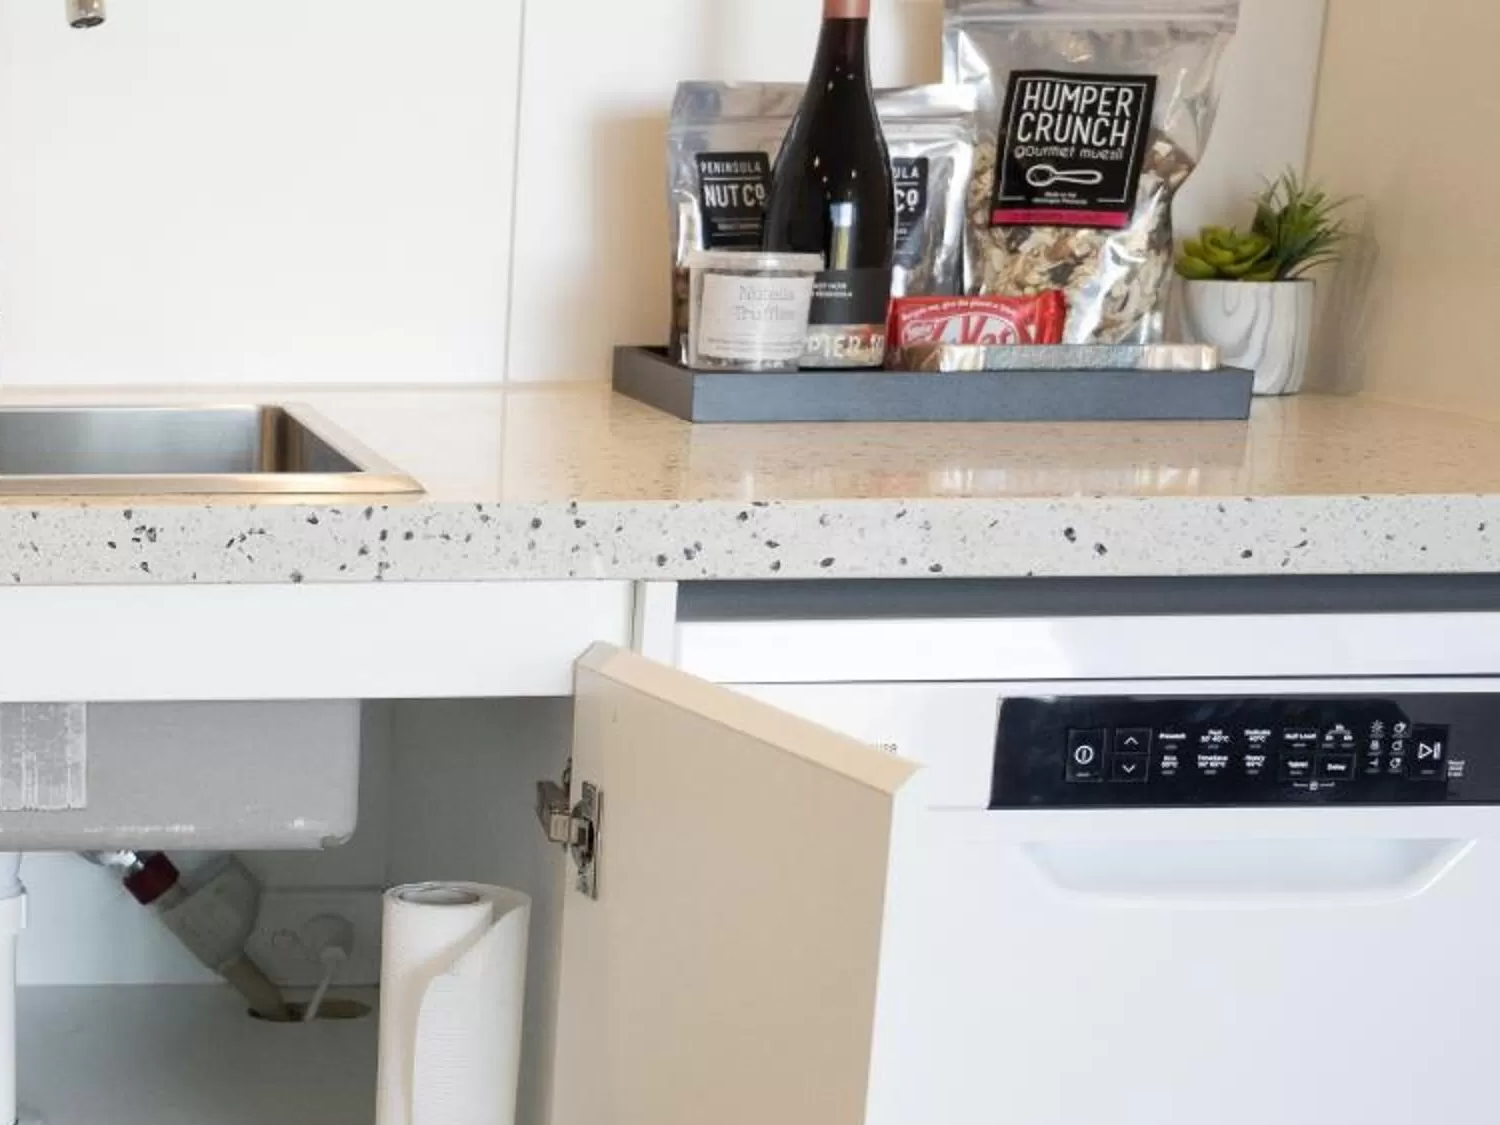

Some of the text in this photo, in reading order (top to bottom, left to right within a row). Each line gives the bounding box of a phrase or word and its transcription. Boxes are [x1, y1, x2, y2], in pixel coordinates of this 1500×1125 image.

[1023, 82, 1134, 117] HUMPER
[1017, 112, 1130, 147] CRUNCH
[1014, 146, 1124, 161] gourmet muesli
[701, 160, 762, 174] PENINSULA
[704, 184, 739, 208] NUT
